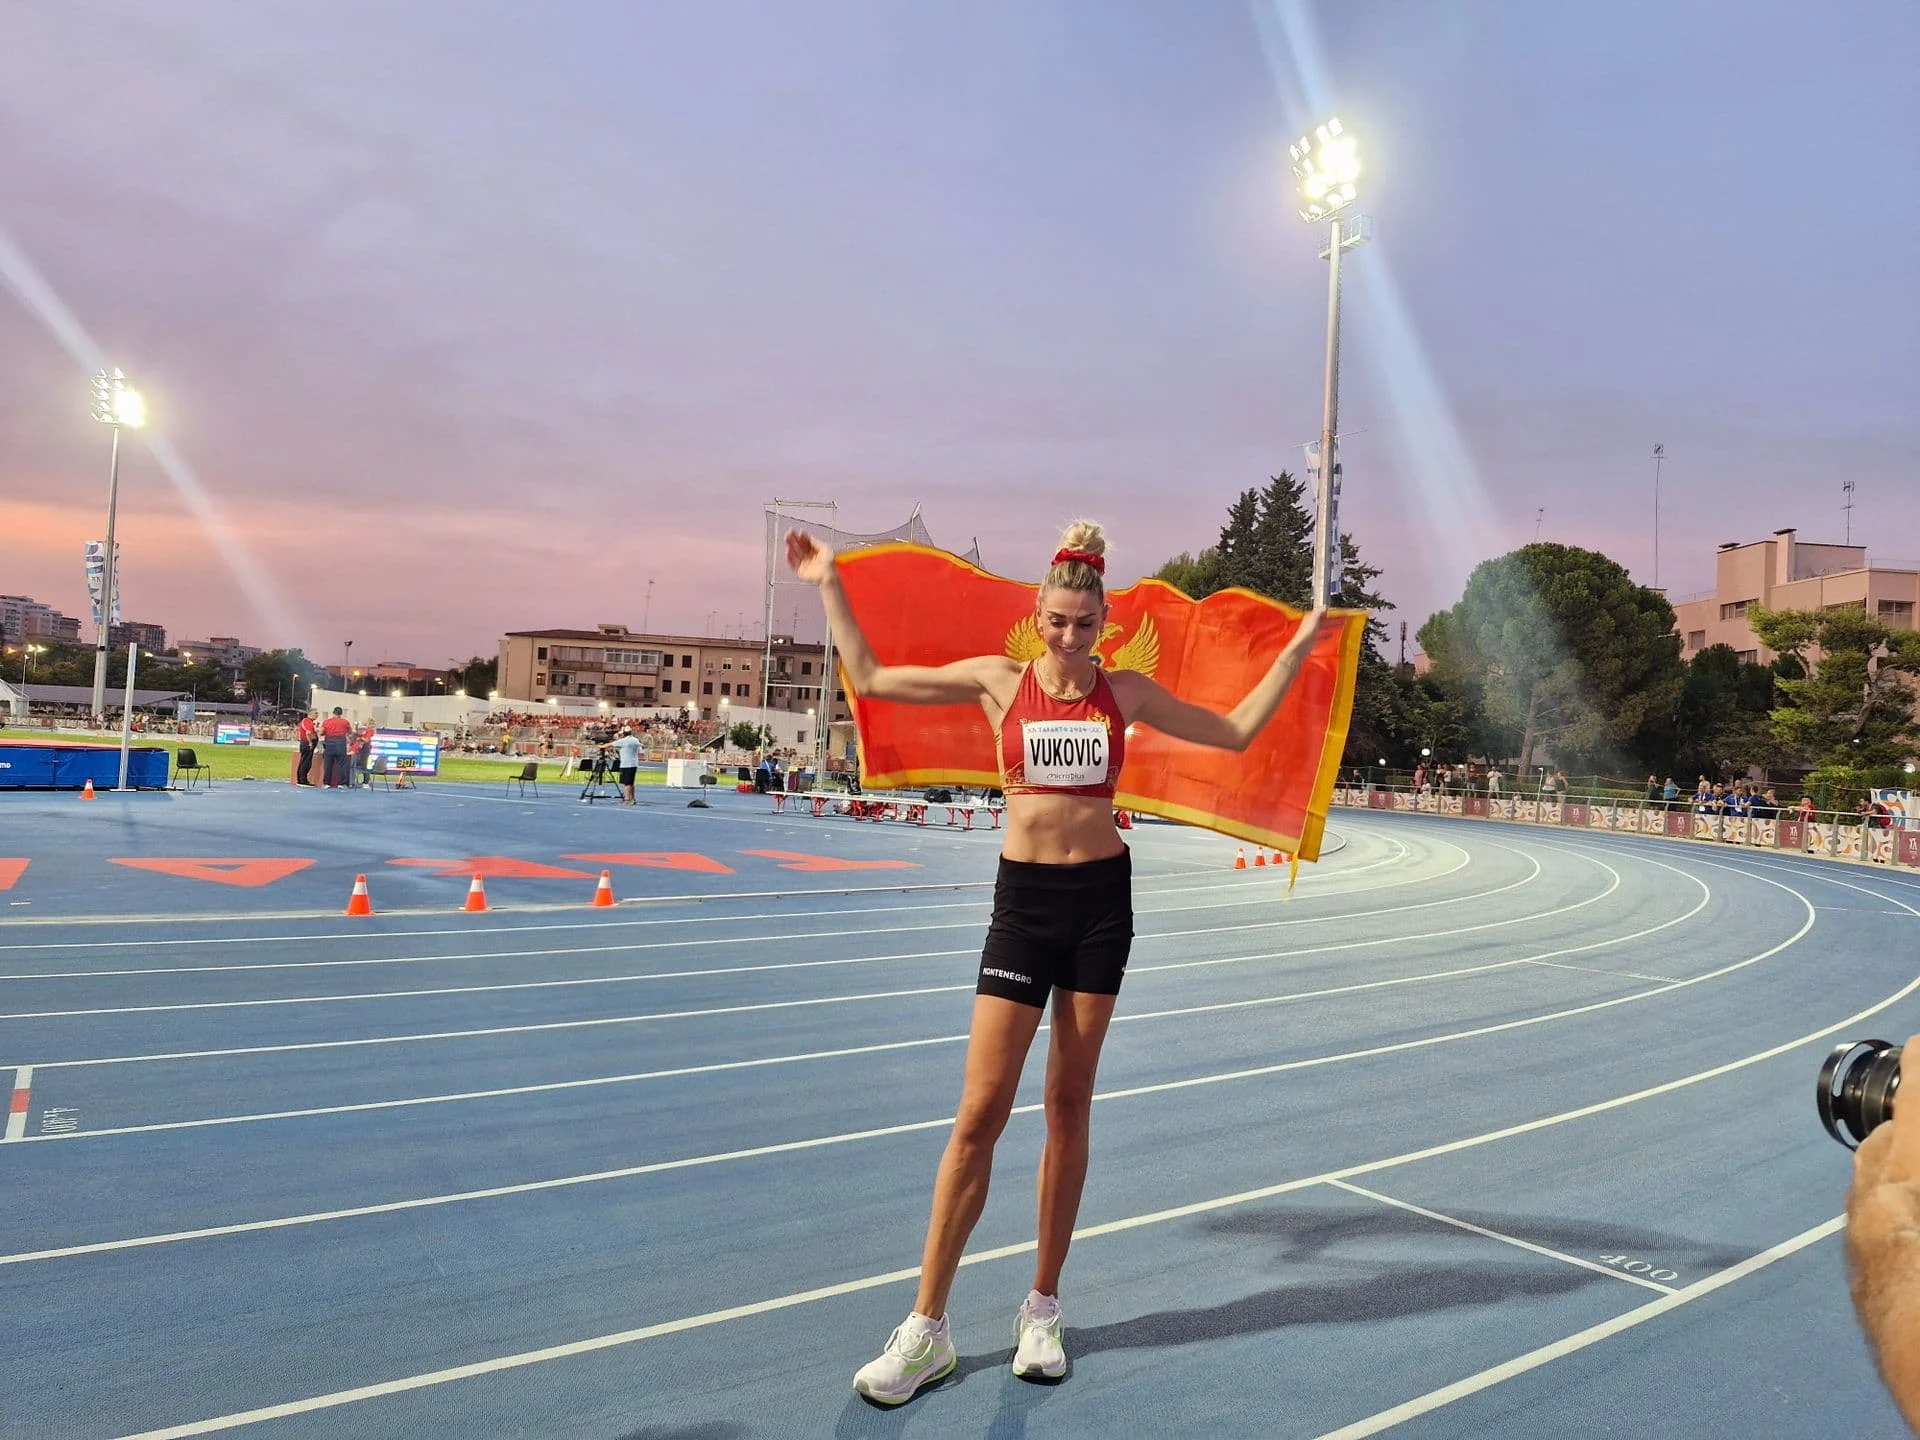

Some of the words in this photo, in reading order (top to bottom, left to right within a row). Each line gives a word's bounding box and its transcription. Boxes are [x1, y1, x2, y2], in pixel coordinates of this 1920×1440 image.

[1030, 738, 1101, 766] VUKOVIC
[0, 849, 922, 891] TARA
[983, 967, 1031, 984] MONTENEGRO
[1599, 1255, 1678, 1281] 400
